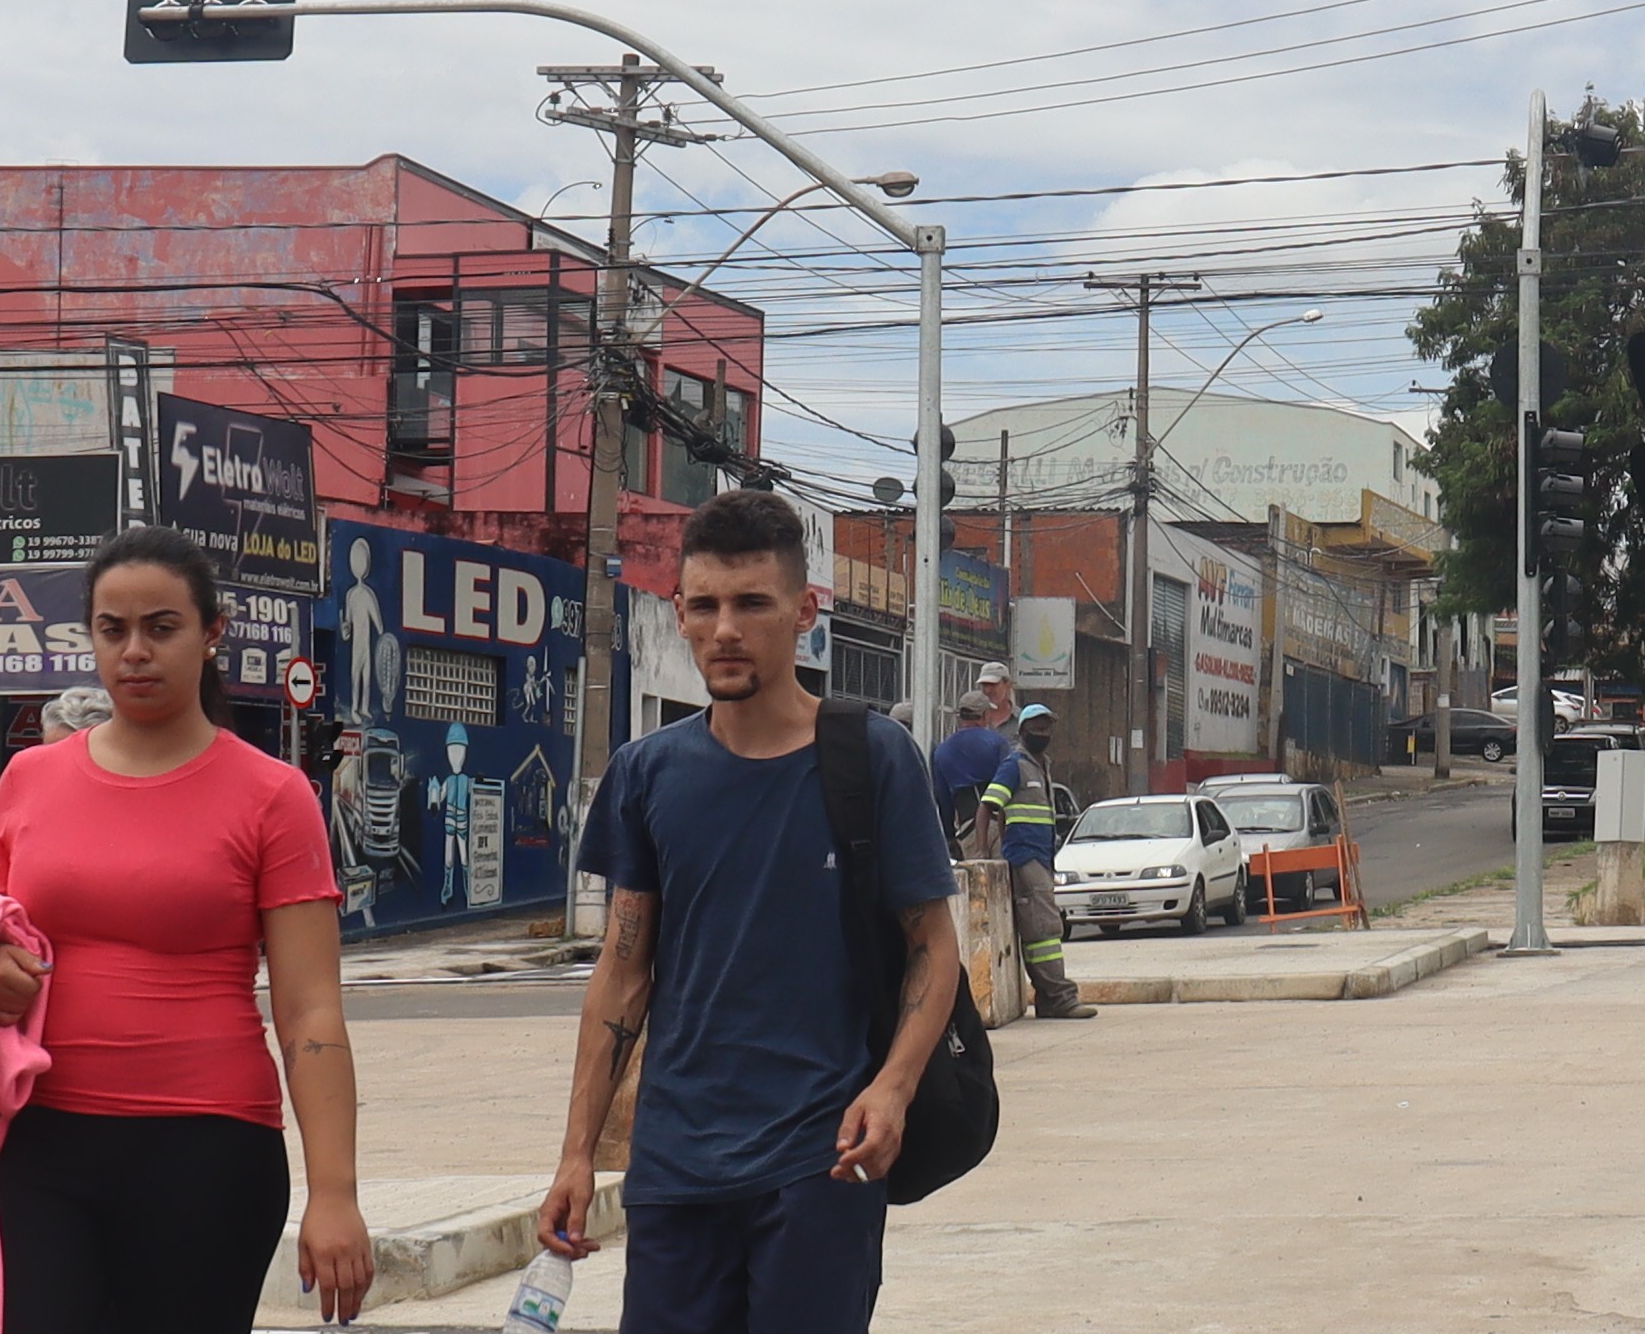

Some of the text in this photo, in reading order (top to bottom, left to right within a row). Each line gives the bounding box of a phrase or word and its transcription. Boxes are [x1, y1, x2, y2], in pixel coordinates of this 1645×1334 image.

[118, 354, 147, 529] BATE
[27, 537, 39, 546] 19
[27, 549, 39, 559] 19
[209, 531, 238, 551] nova
[243, 531, 274, 557] LOJA
[277, 538, 291, 559] do
[294, 540, 316, 564] LED
[402, 550, 546, 646] LED
[1201, 605, 1253, 649] Multimarcas
